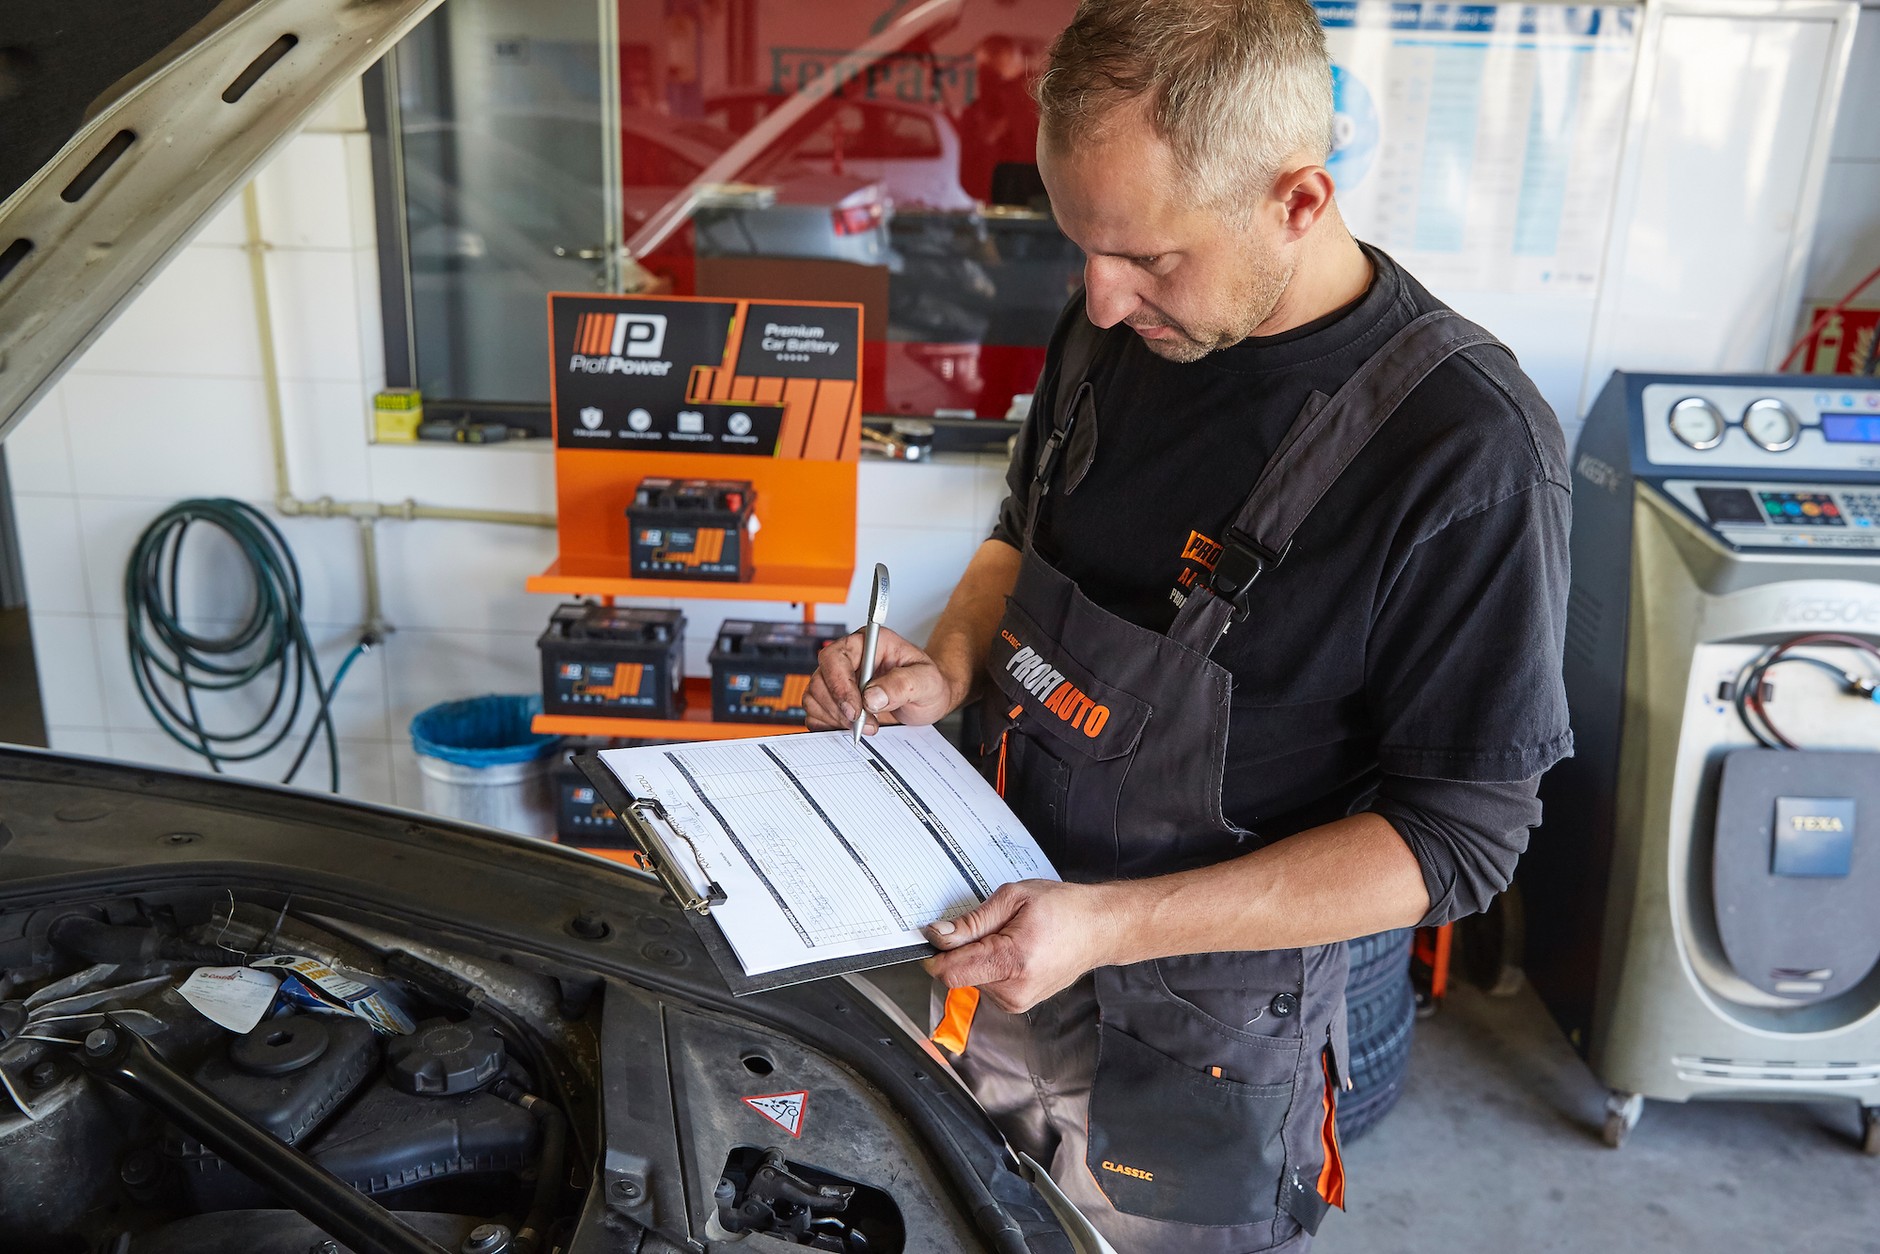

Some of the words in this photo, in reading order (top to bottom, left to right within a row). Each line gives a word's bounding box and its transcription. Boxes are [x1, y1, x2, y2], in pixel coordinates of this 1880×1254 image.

[769, 46, 977, 106] Ferrari
[764, 322, 825, 339] Premium
[761, 337, 786, 351] Car
[786, 338, 840, 356] Battery
[569, 354, 673, 377] ProfiPower
[1001, 629, 1022, 650] CLASSIC
[1005, 645, 1110, 738] PROFIAUTO
[1790, 815, 1845, 833] TEXA
[1101, 1160, 1154, 1182] CLASSIC
